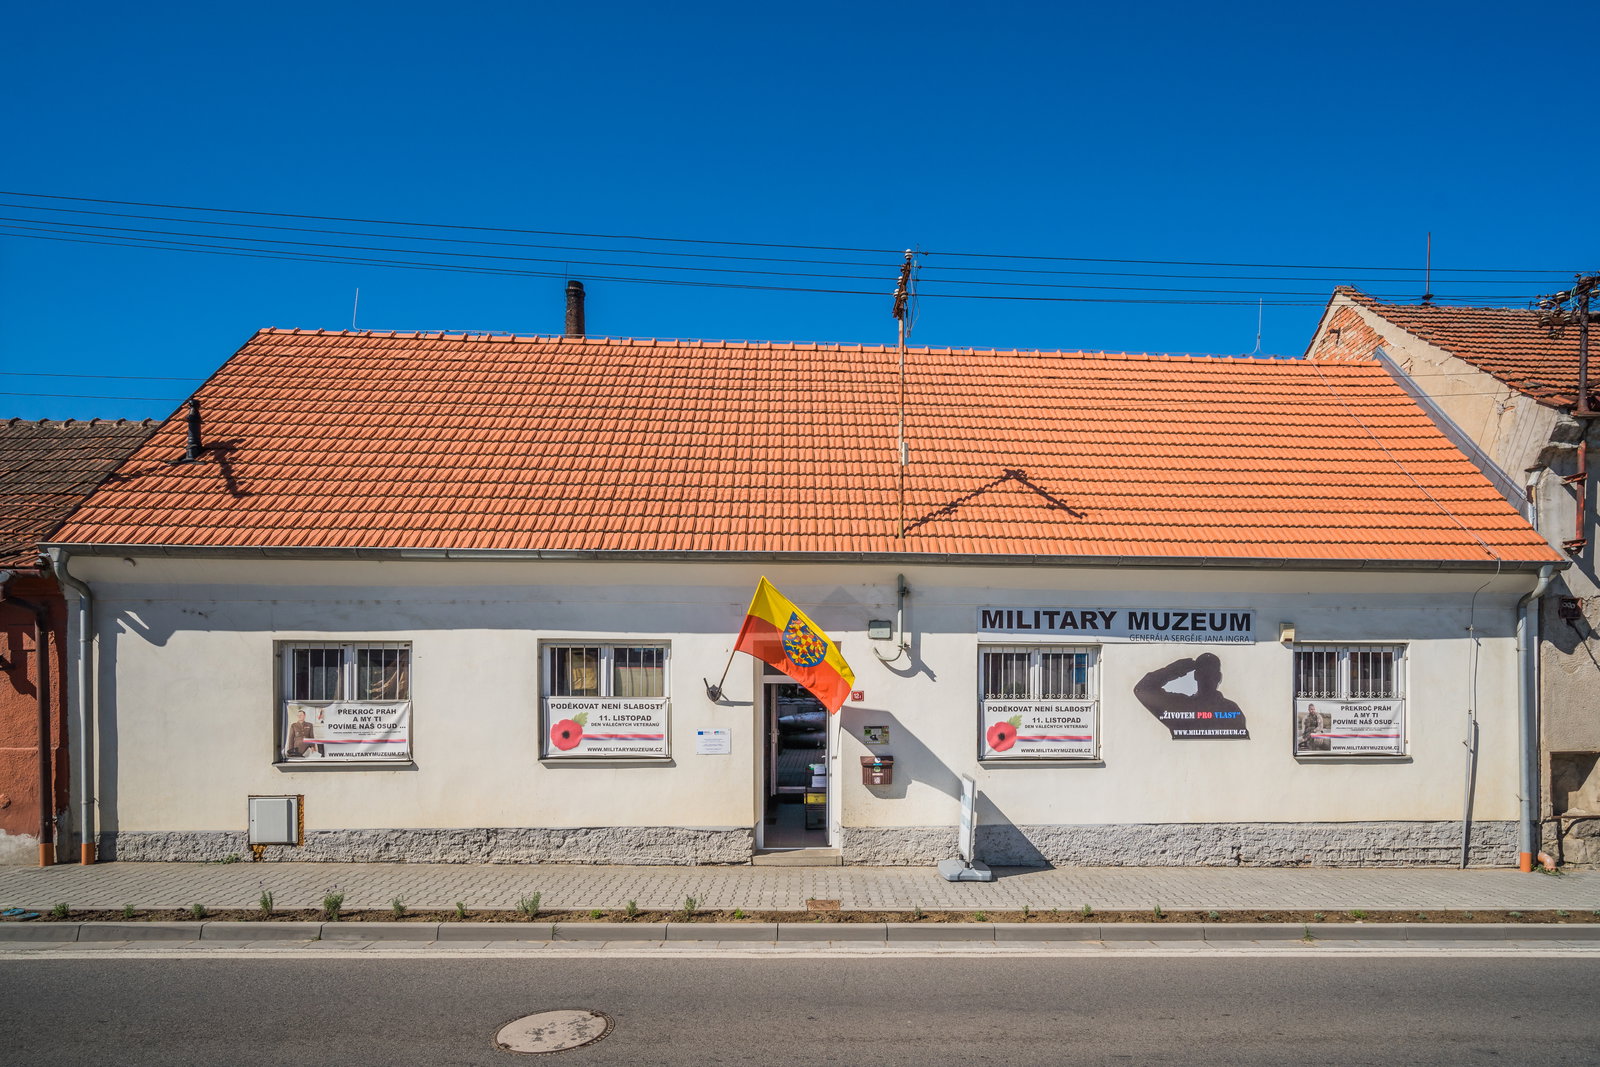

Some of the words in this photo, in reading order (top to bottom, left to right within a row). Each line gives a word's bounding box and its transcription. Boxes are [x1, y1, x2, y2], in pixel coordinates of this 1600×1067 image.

[981, 609, 1117, 630] MILITARY
[1128, 611, 1251, 632] MUZEUM
[1129, 632, 1169, 642] GENERÁLA
[1204, 634, 1224, 643] JANA
[1225, 635, 1250, 643] INGRA
[550, 702, 599, 710] PODĚKOVAT
[601, 702, 621, 710] NENÍ
[987, 705, 1032, 713] PODĚKOVAT
[1034, 705, 1053, 713] NENÍ
[1197, 711, 1212, 719] PRO
